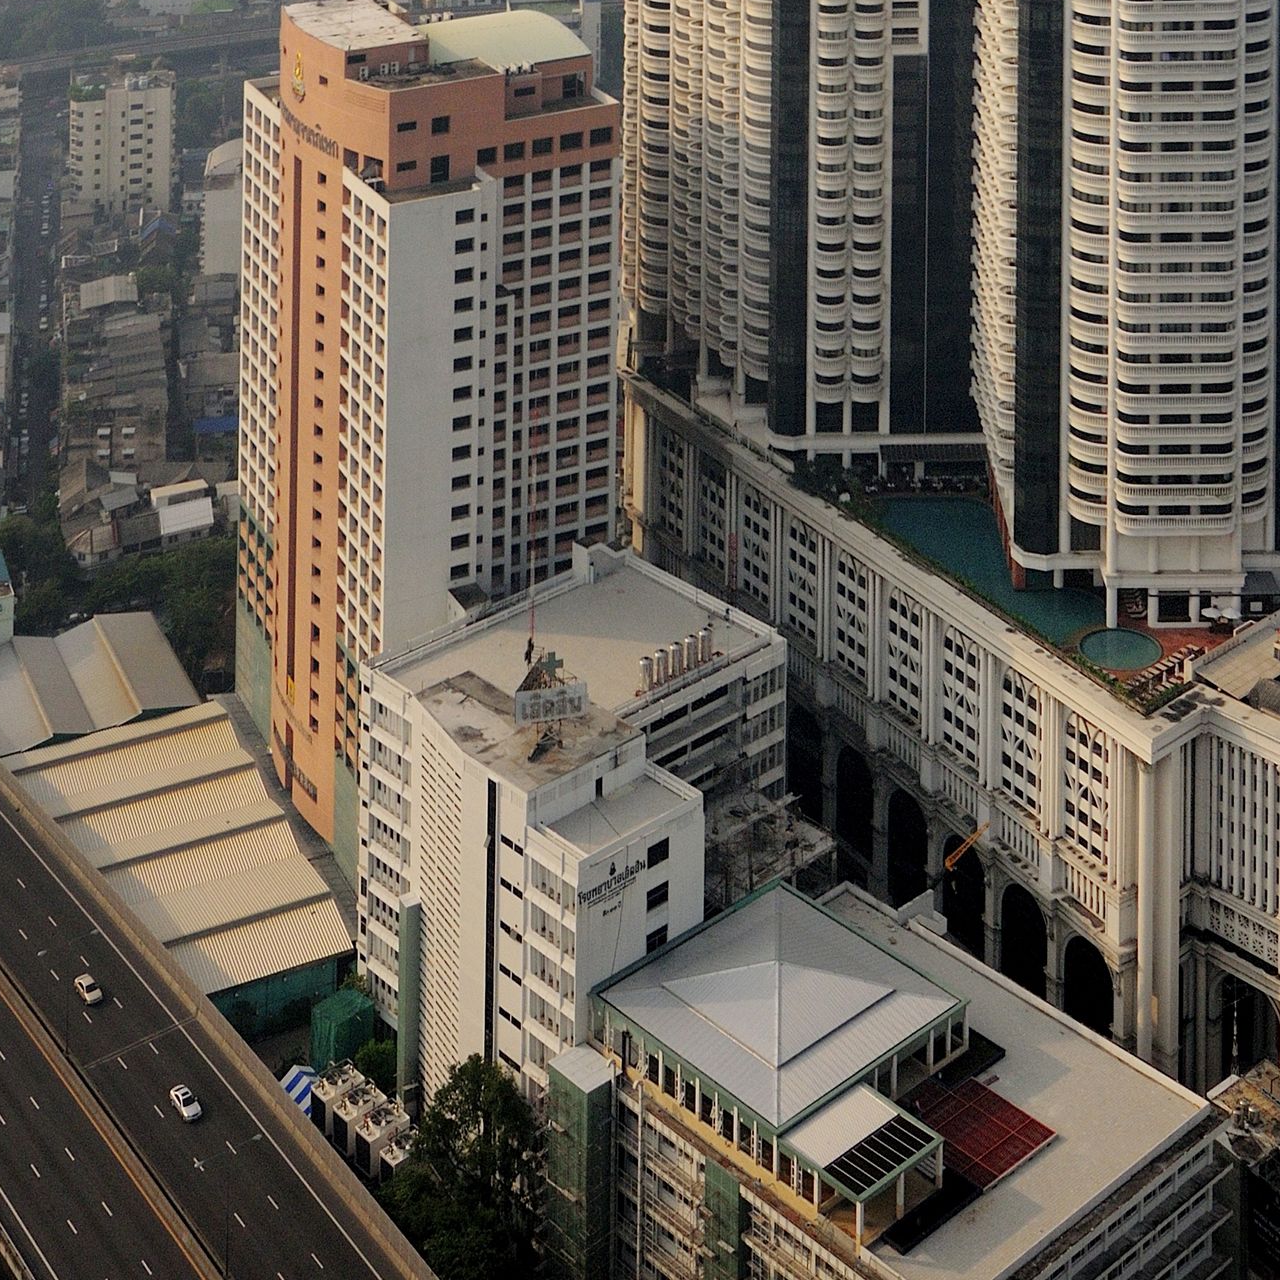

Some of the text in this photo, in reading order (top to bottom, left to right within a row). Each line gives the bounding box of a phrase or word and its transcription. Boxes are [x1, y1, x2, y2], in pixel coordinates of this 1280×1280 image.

[577, 859, 646, 906] โรงพยาบาลเลิดสิน
